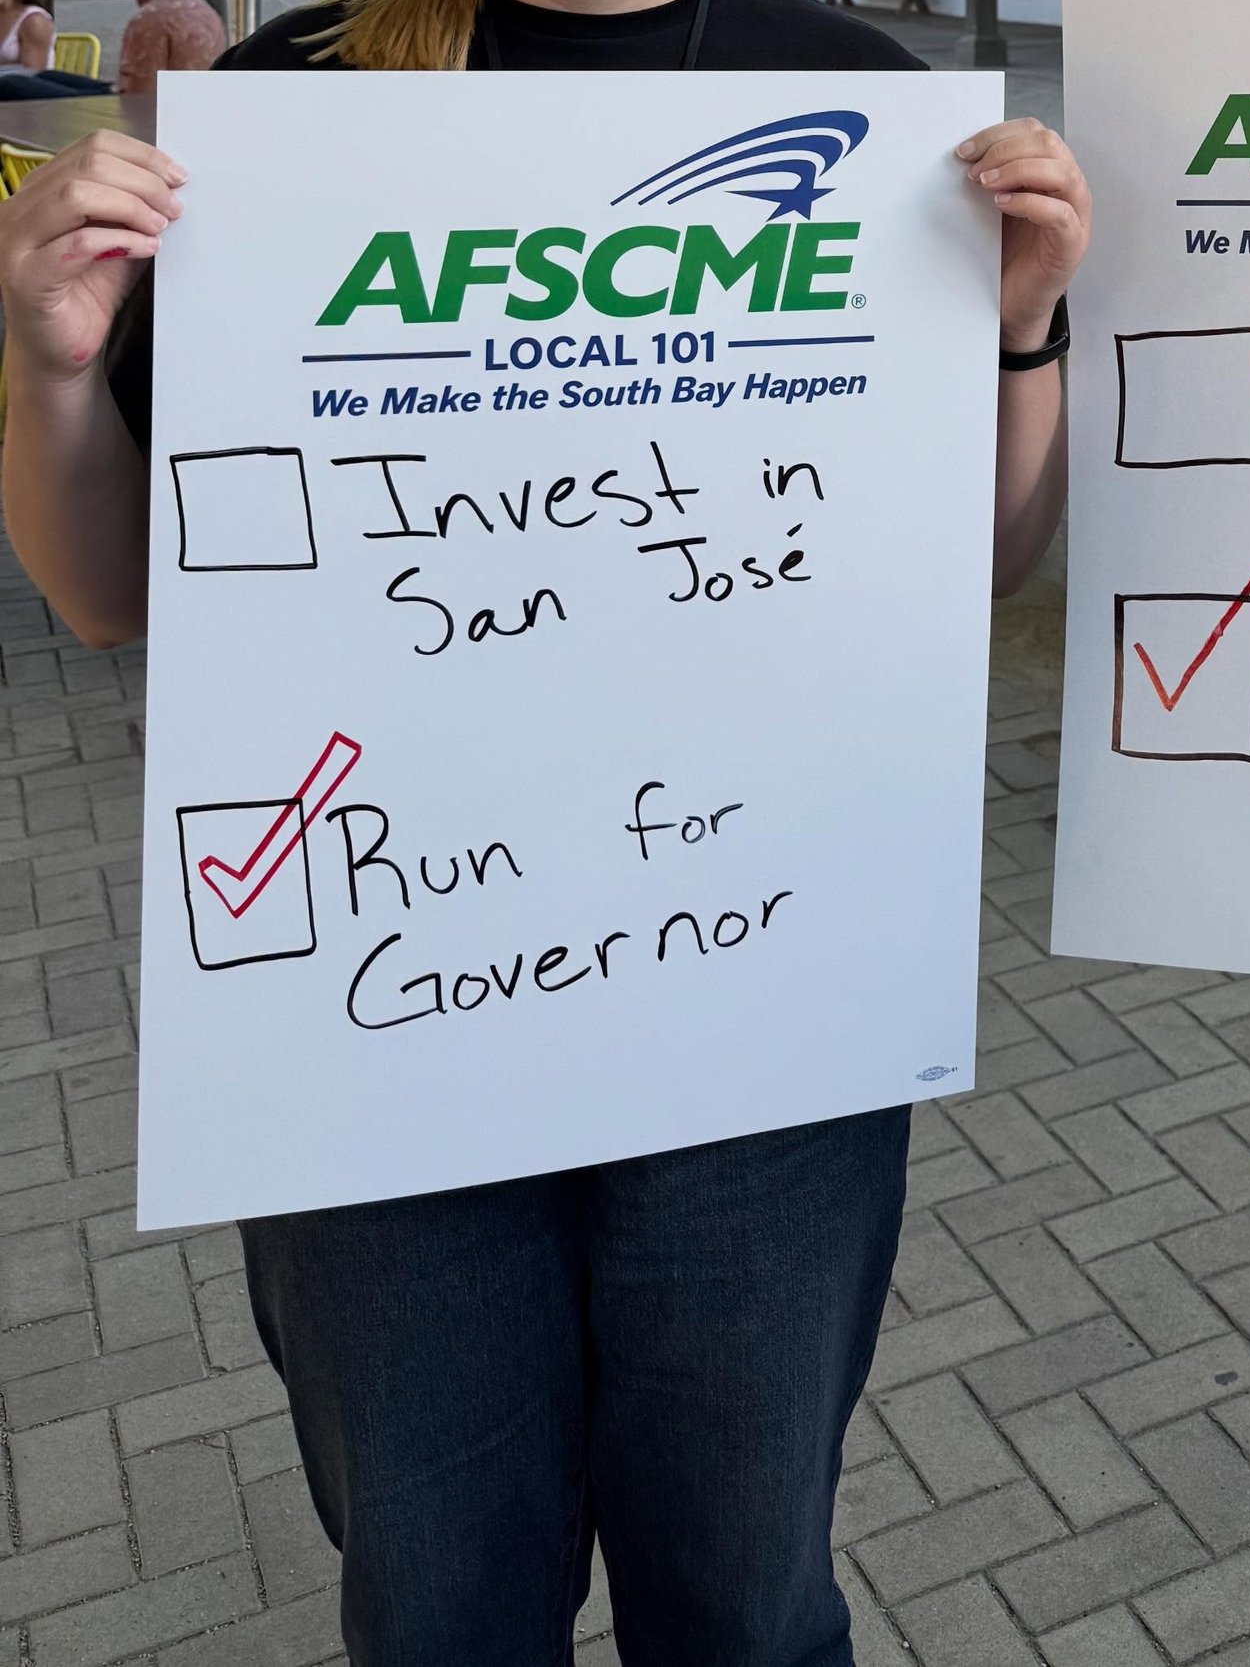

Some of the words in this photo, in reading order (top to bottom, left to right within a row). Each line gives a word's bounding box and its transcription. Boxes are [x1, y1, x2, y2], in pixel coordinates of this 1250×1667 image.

[1186, 230, 1229, 254] We
[313, 389, 368, 417] We
[380, 385, 481, 415] Make
[493, 383, 549, 411] the
[559, 378, 661, 408] South
[671, 376, 736, 408] Bay
[743, 373, 867, 404] Happen
[485, 335, 637, 370] LOCAL
[652, 331, 714, 364] 101
[330, 441, 700, 539] Invest
[763, 458, 824, 501] in
[386, 567, 567, 655] San
[638, 523, 812, 603] José
[326, 803, 523, 916] Run
[625, 781, 743, 860] for
[347, 891, 793, 1029] Governor
